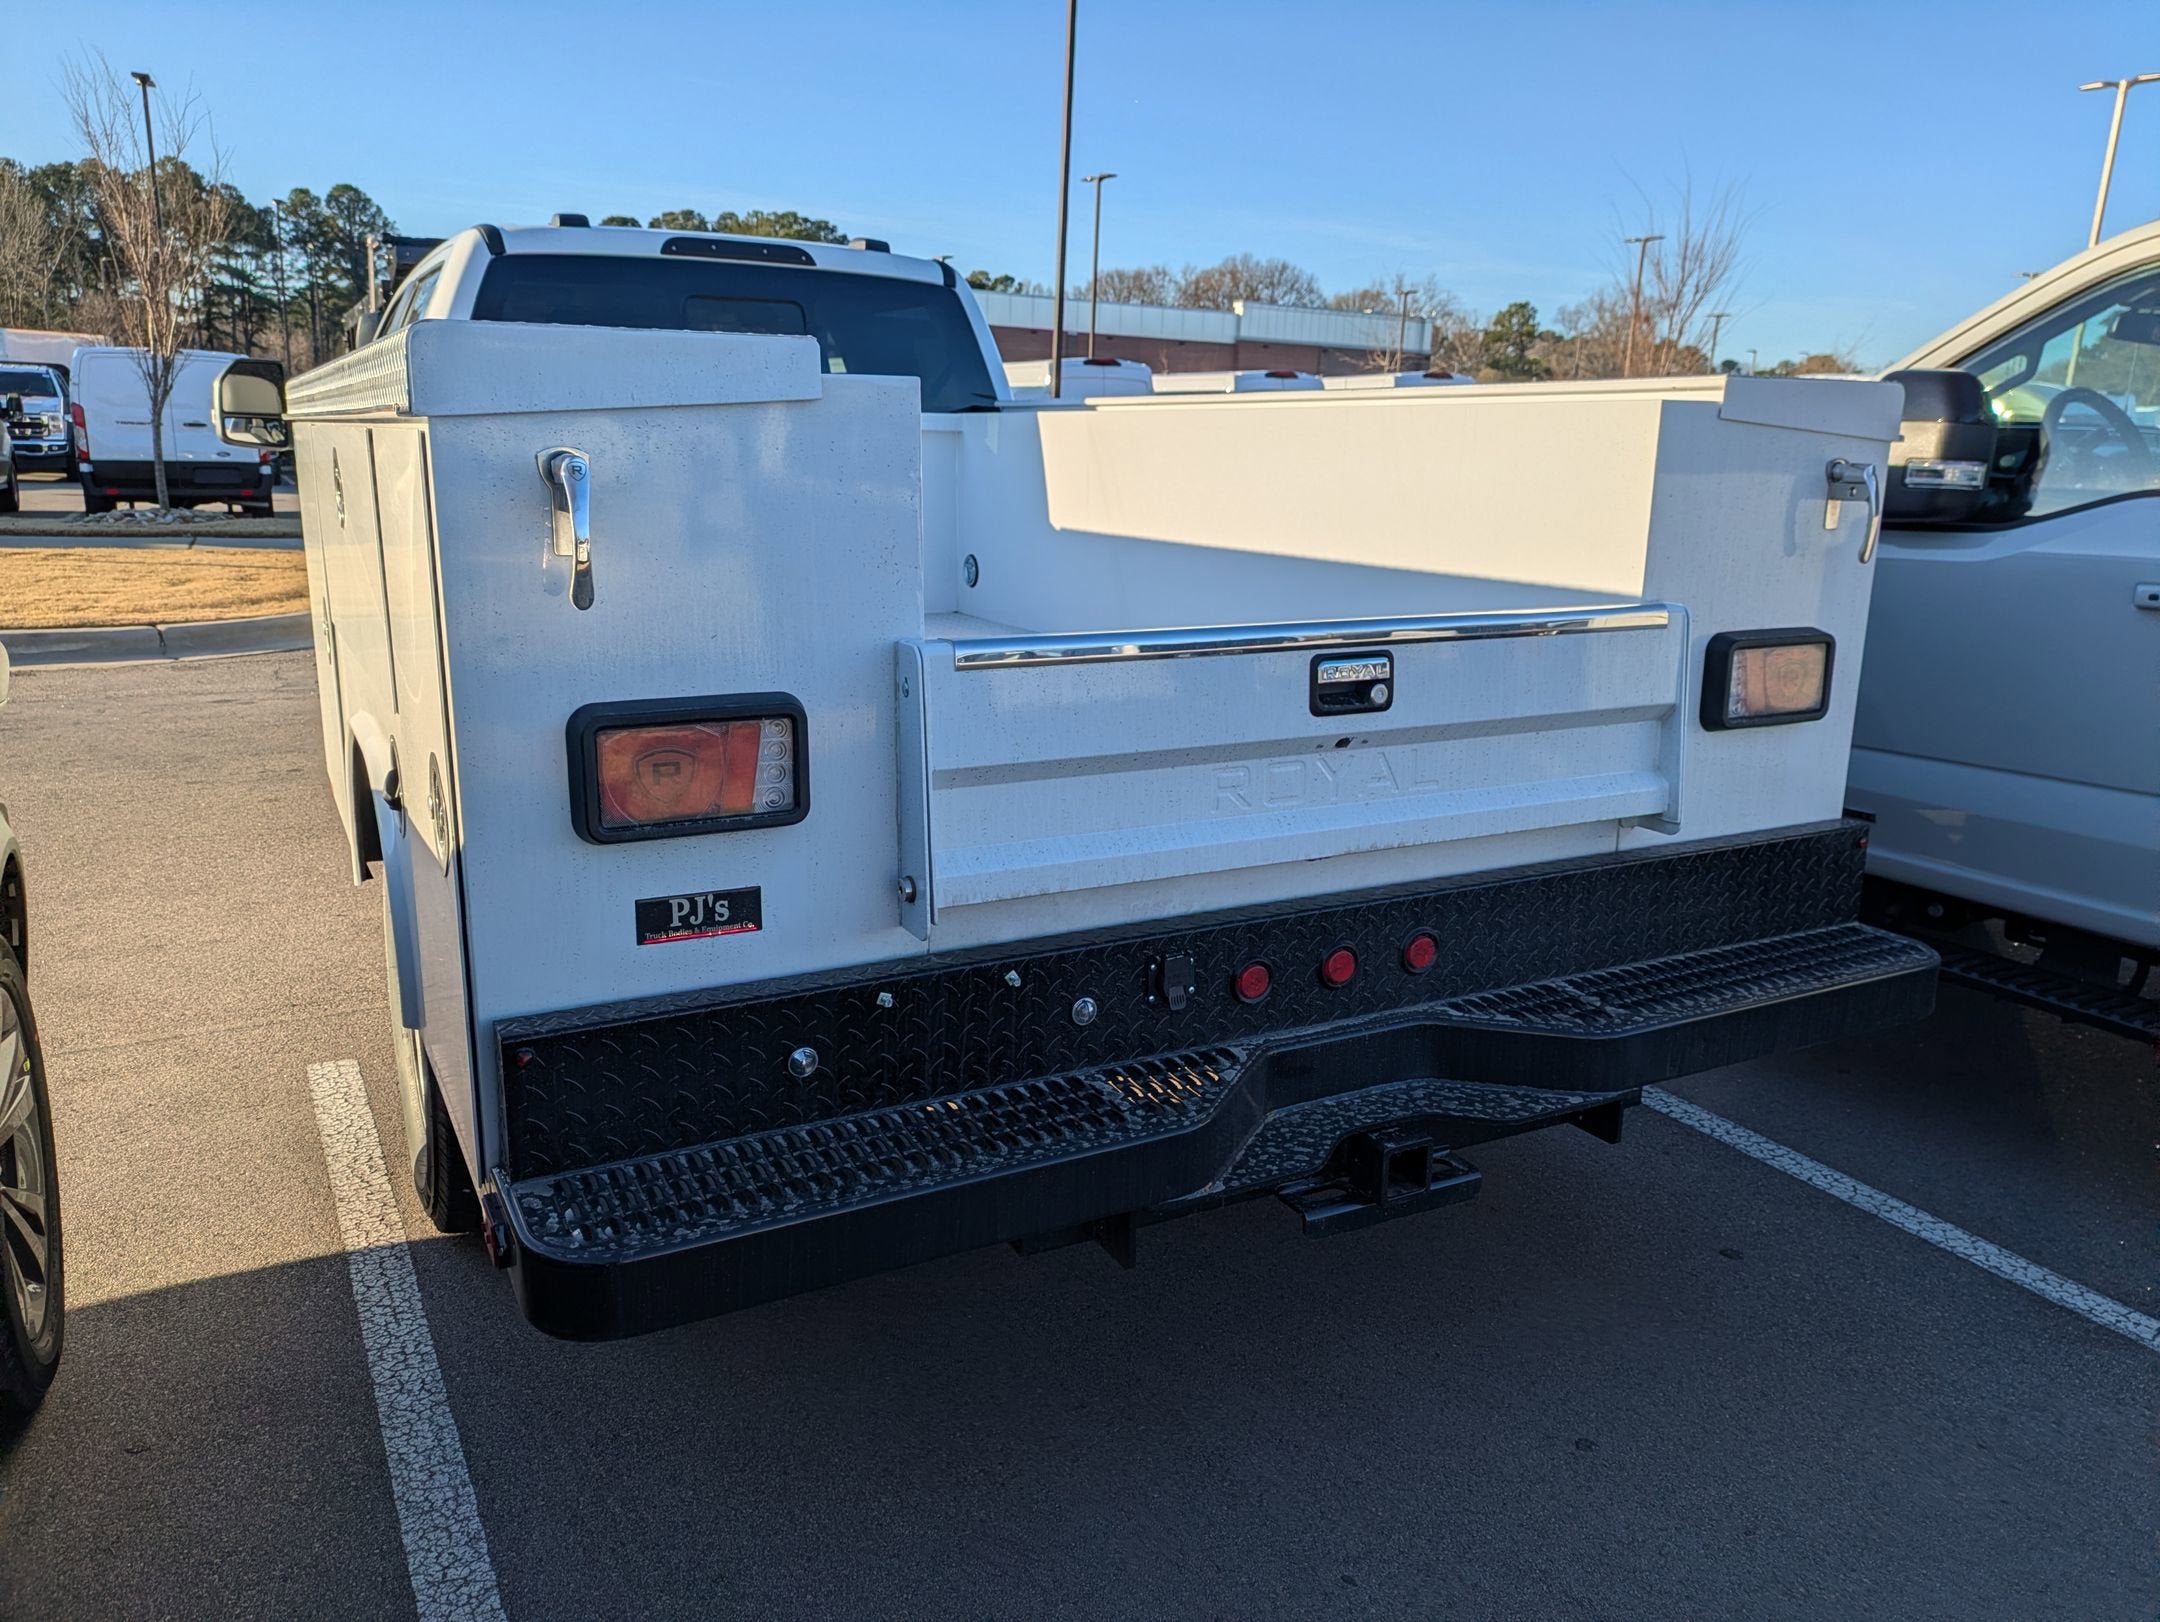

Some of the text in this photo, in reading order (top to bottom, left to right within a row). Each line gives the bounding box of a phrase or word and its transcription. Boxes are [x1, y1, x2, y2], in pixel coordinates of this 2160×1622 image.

[572, 465, 583, 477] R
[1321, 662, 1388, 681] ROYAL
[1210, 749, 1439, 814] ROYAL
[669, 894, 730, 927] PJ's
[645, 931, 668, 940] Truck
[668, 928, 693, 938] Bodies
[701, 922, 741, 934] Equipment
